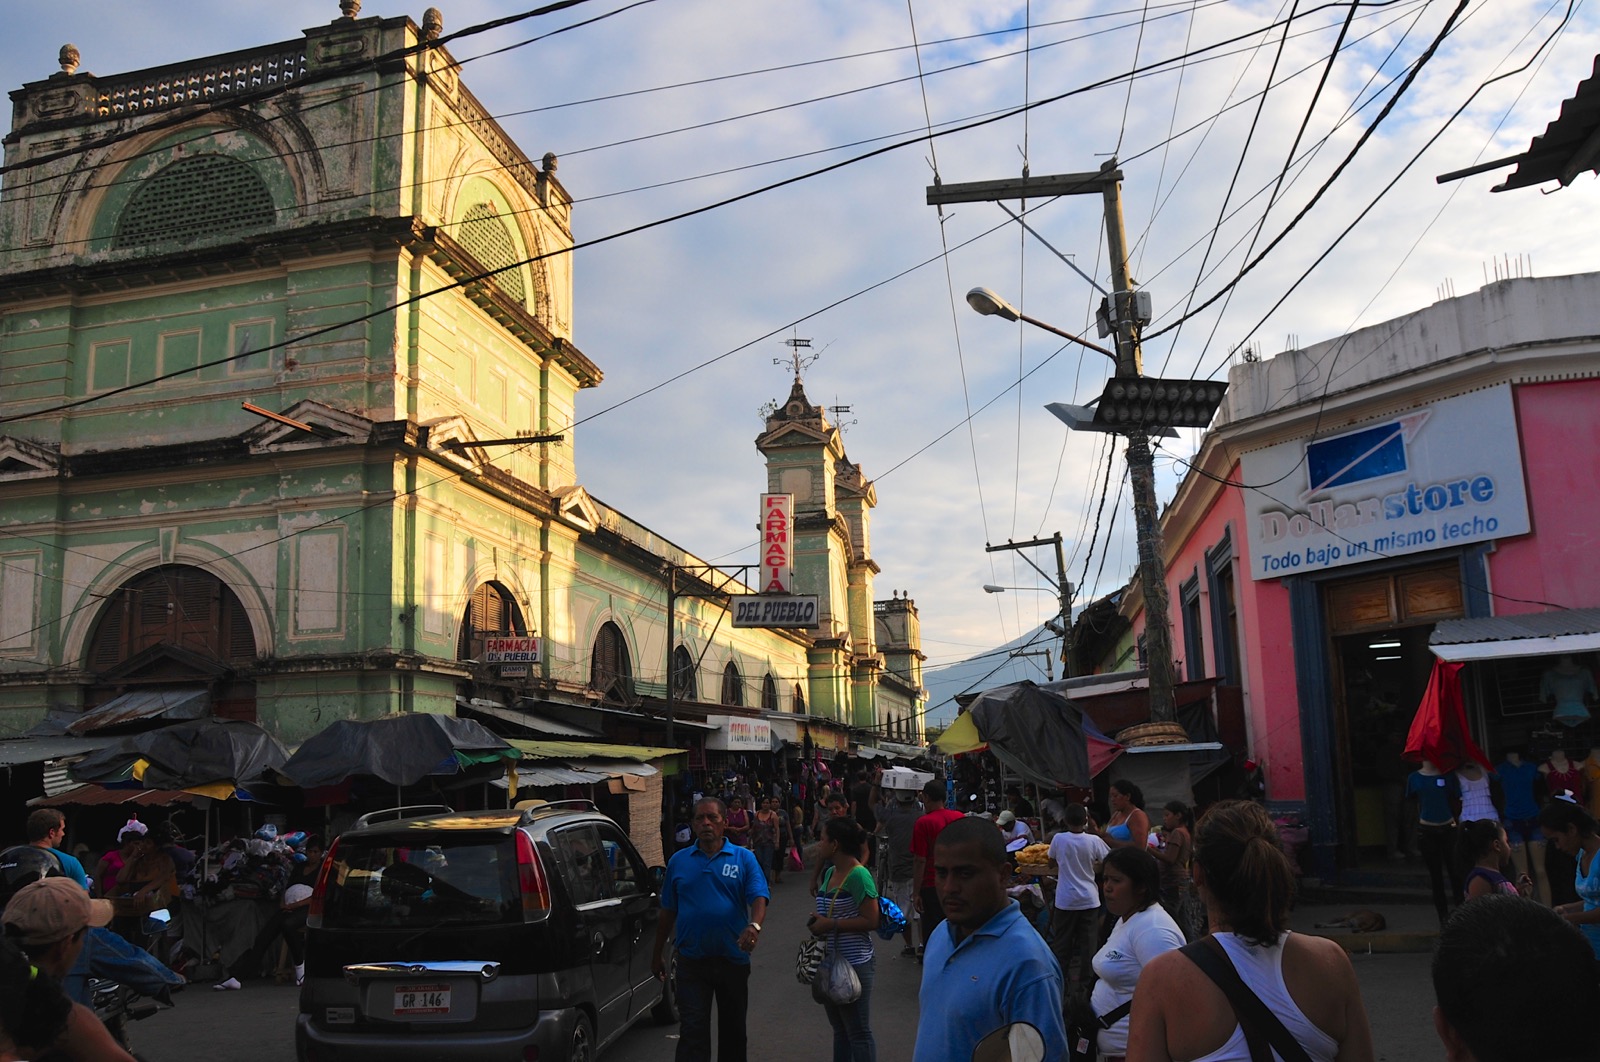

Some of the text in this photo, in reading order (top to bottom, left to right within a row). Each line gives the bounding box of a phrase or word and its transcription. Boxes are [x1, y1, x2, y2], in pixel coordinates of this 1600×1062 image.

[765, 497, 787, 591] FARMACIA
[1262, 515, 1498, 572] Todo bajo un mismo techo
[736, 601, 815, 622] DEL PUEBLO
[487, 639, 537, 652] FARMACIA
[503, 652, 537, 661] PUEBLO
[722, 863, 739, 879] 02
[402, 992, 442, 1008] GR 146
